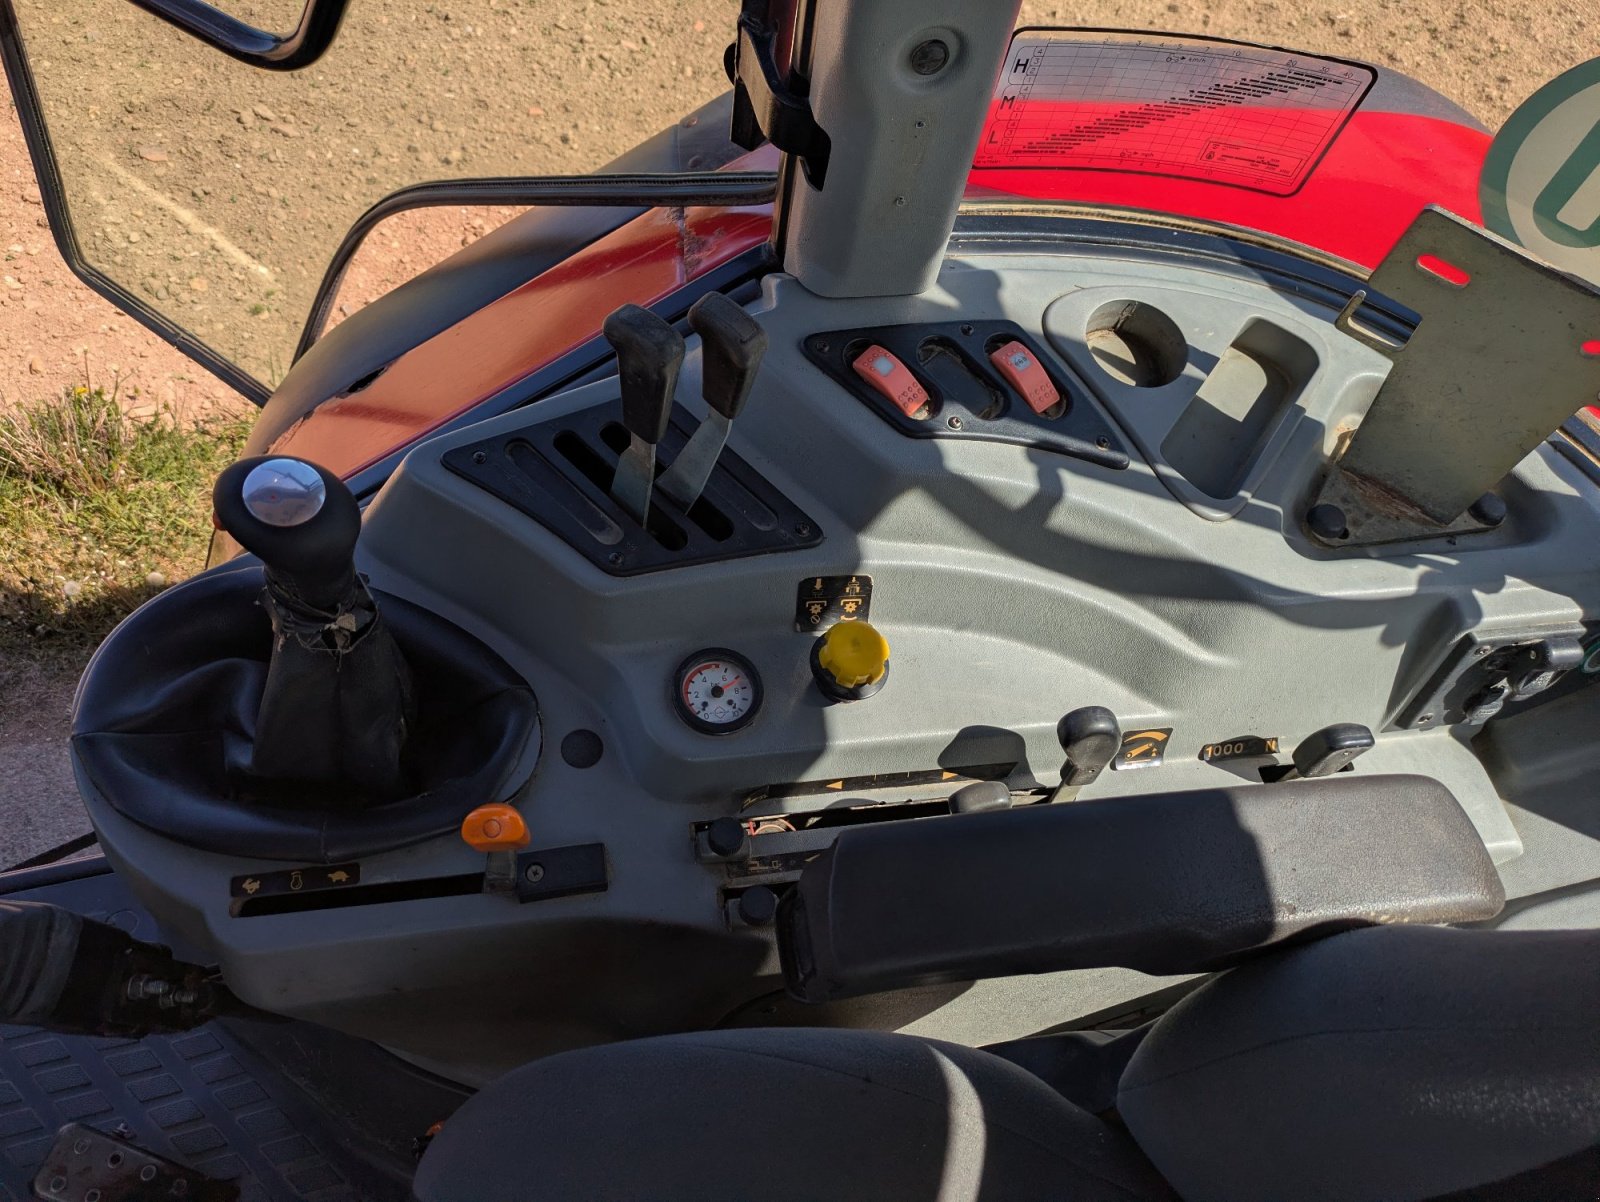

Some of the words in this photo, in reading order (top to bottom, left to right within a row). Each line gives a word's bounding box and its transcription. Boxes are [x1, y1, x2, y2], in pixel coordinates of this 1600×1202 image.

[1013, 58, 1029, 73] H
[1285, 59, 1298, 67] 20
[1320, 66, 1330, 74] 30
[1343, 71, 1354, 79] 40
[1000, 95, 1016, 109] M
[988, 131, 998, 144] L
[1205, 742, 1244, 758] 1000
[1265, 740, 1278, 752] N
